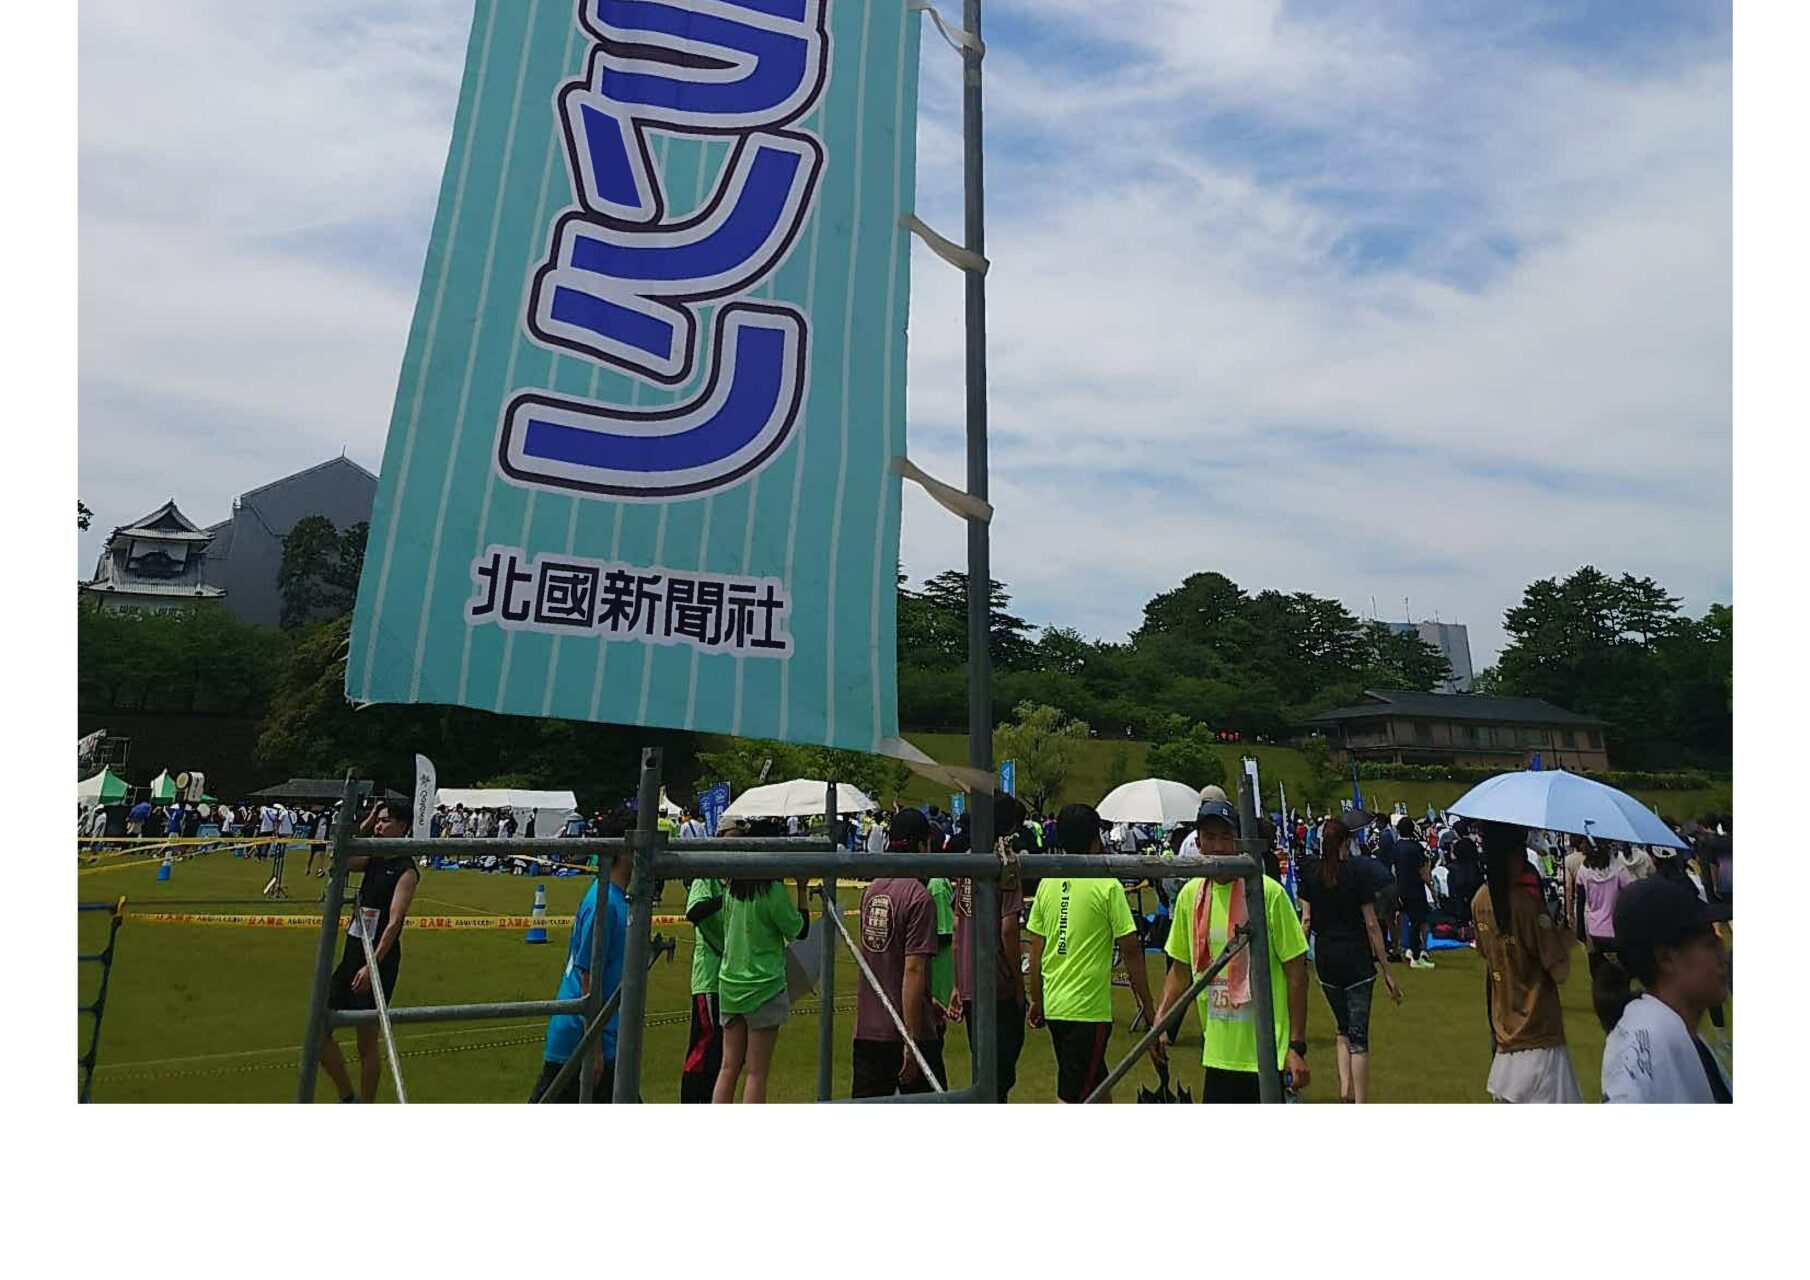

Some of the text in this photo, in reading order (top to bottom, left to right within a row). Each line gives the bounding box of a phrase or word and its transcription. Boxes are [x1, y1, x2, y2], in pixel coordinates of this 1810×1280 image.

[471, 553, 787, 650] 北國新聞社
[1213, 989, 1241, 1010] 25
